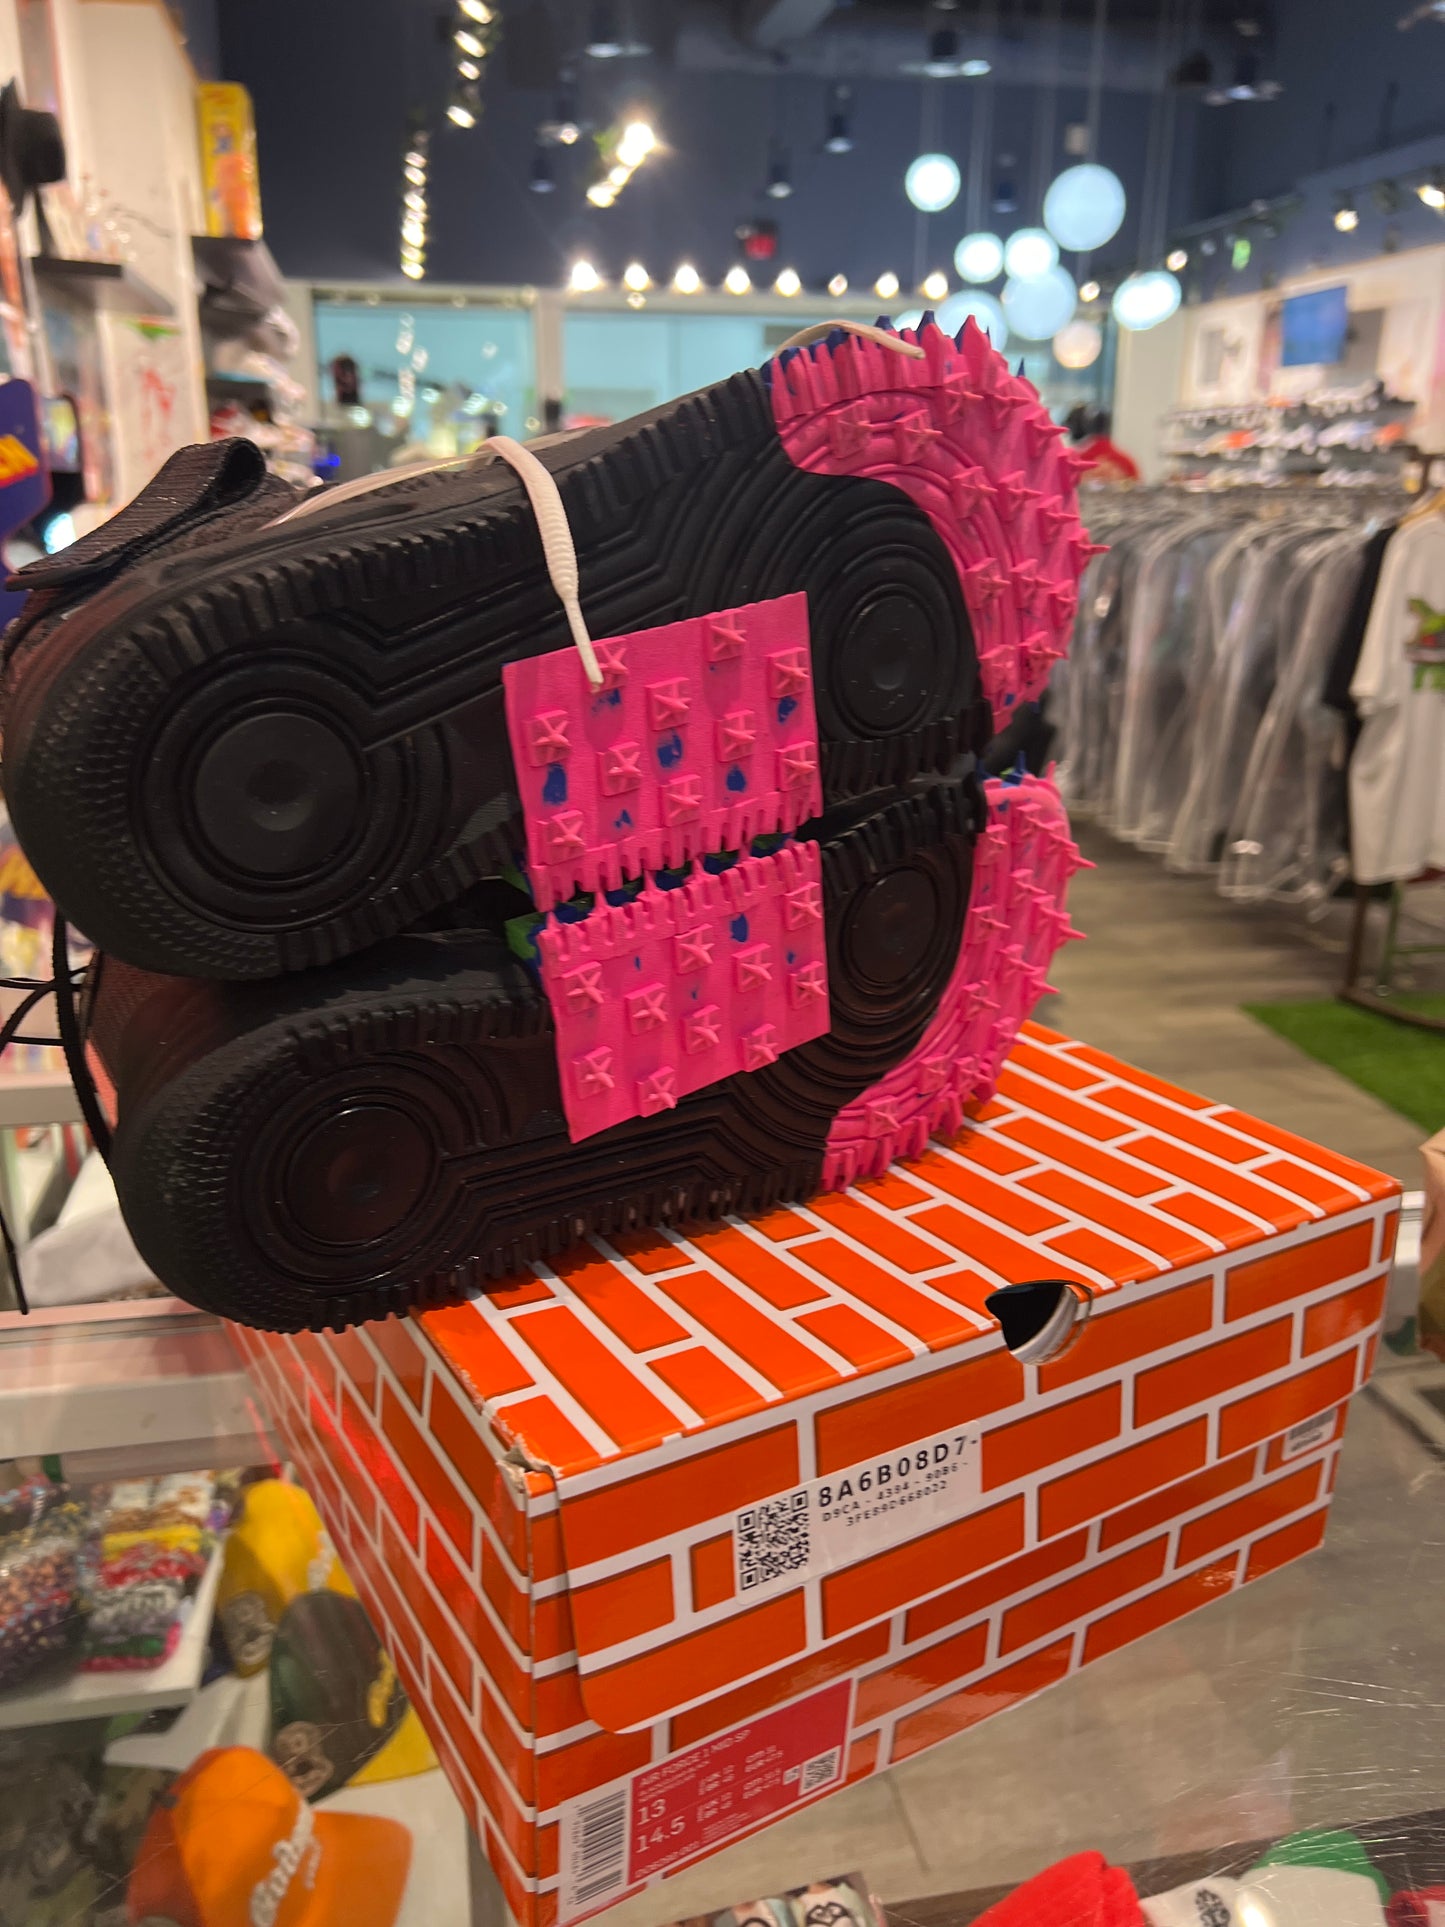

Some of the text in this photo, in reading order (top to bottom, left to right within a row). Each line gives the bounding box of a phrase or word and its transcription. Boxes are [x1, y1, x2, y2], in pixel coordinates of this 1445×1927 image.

[818, 1435, 978, 1507] 8A6B08D7-
[661, 1751, 702, 1777] FORCE
[636, 1798, 666, 1826] 13
[635, 1815, 686, 1854] 14.5
